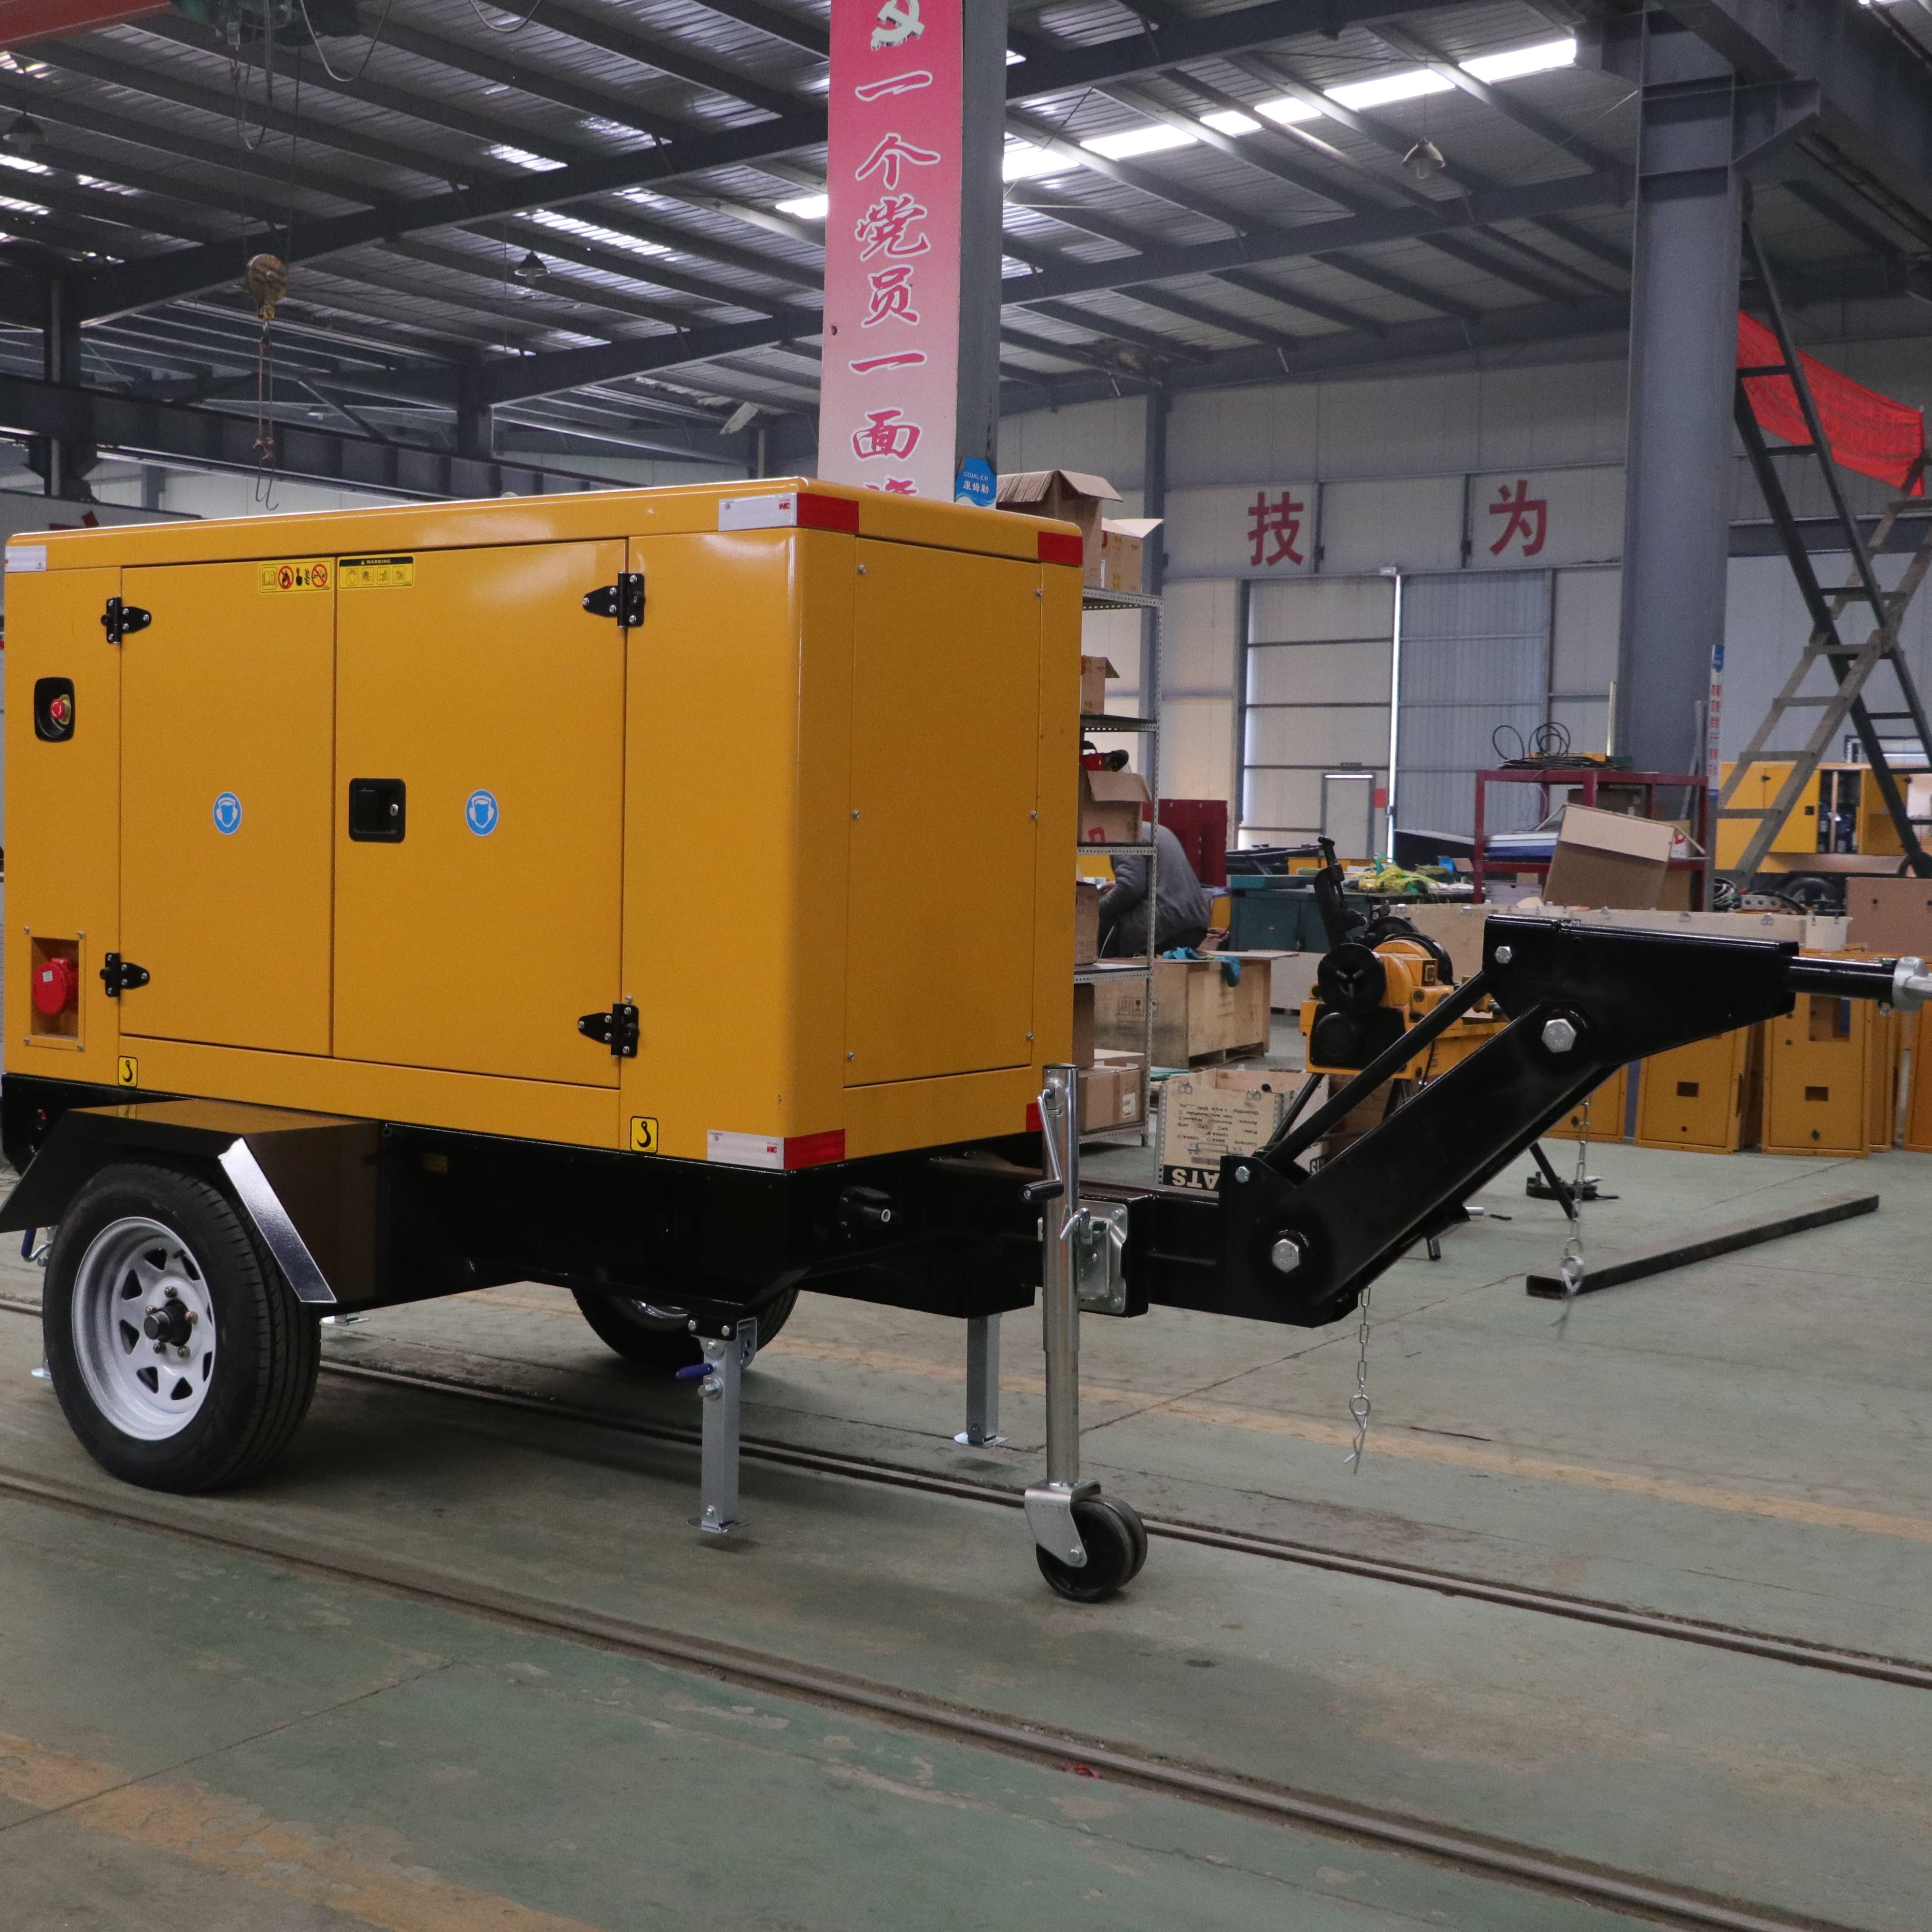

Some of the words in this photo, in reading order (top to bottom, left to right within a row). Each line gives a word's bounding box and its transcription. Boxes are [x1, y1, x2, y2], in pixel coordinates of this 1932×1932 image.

[964, 471, 989, 481] COMLER
[1248, 491, 1304, 566] 技
[1489, 479, 1548, 557] 为
[1172, 1168, 1220, 1190] ATS
